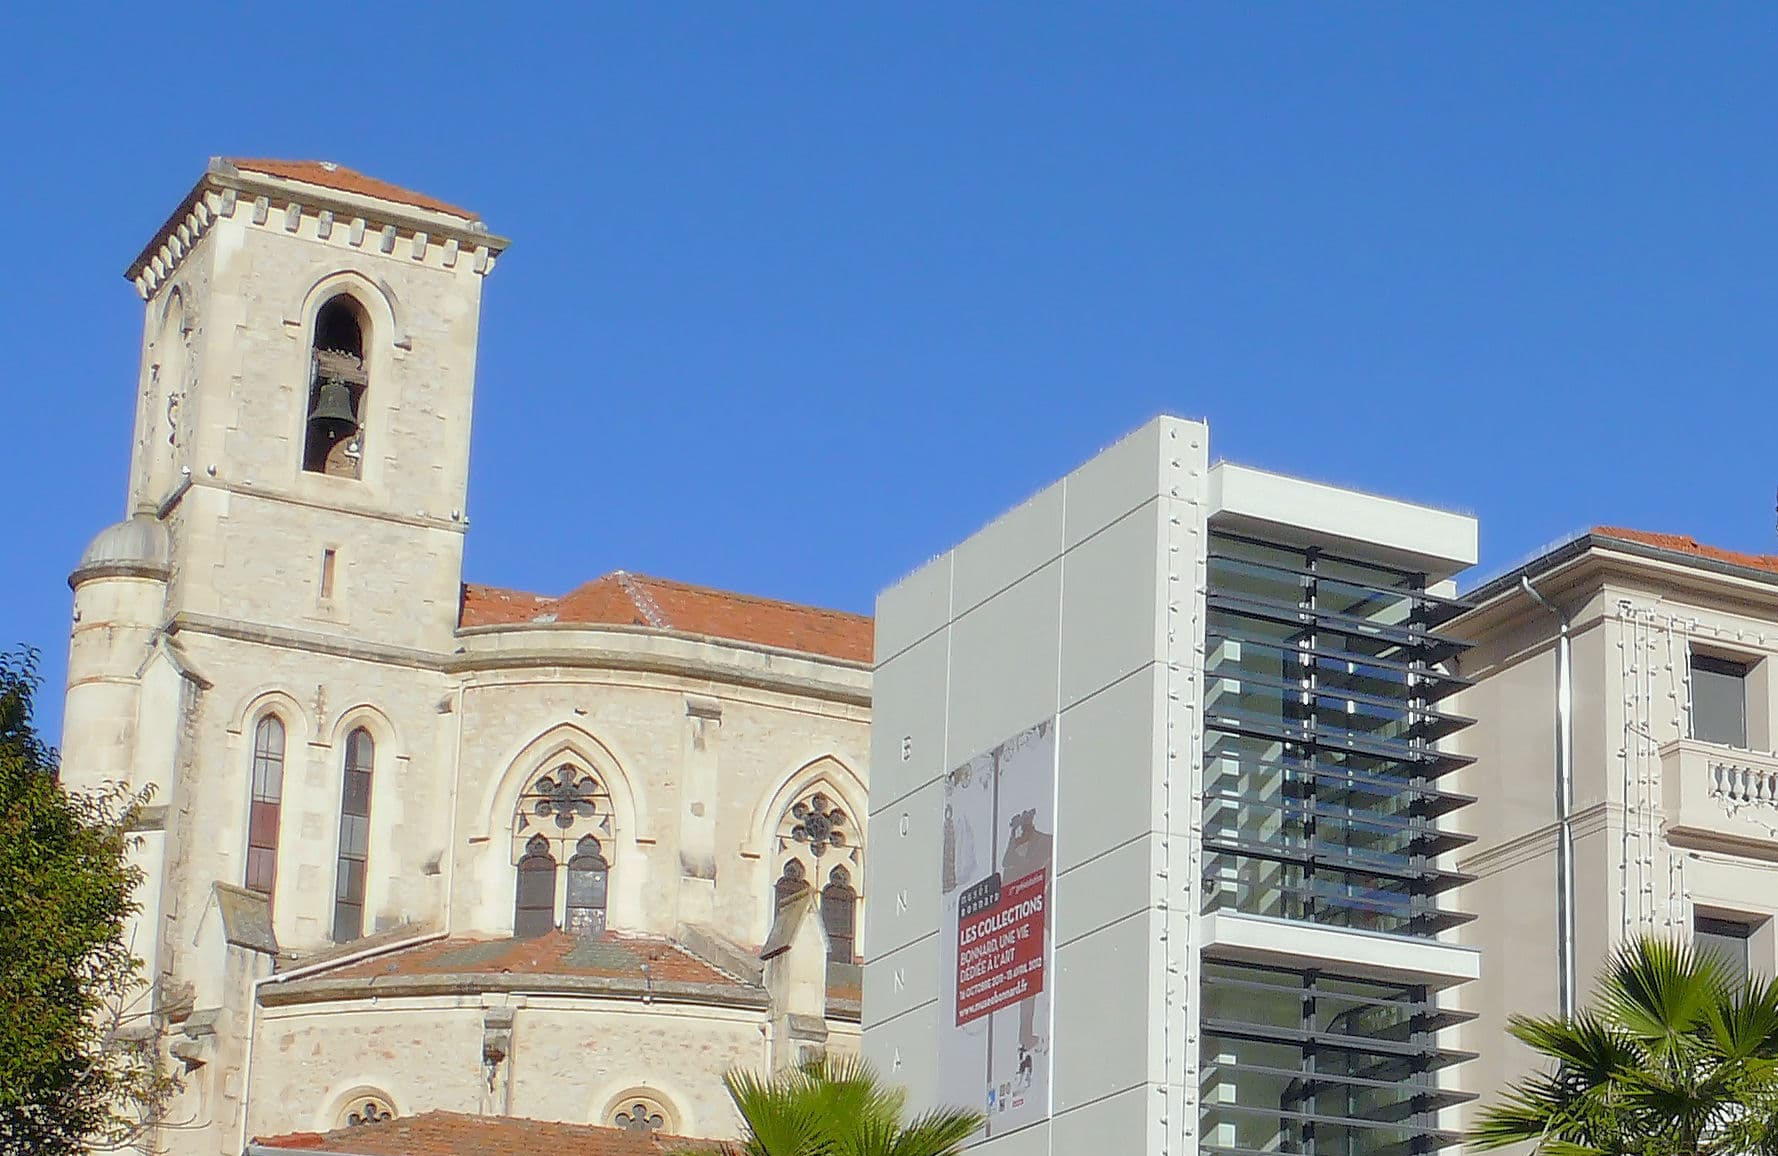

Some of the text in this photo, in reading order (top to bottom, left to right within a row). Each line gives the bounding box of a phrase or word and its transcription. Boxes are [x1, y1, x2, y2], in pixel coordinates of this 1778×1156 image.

[892, 735, 912, 1073] BONNA
[960, 894, 1043, 946] LES COLLECTIONS
